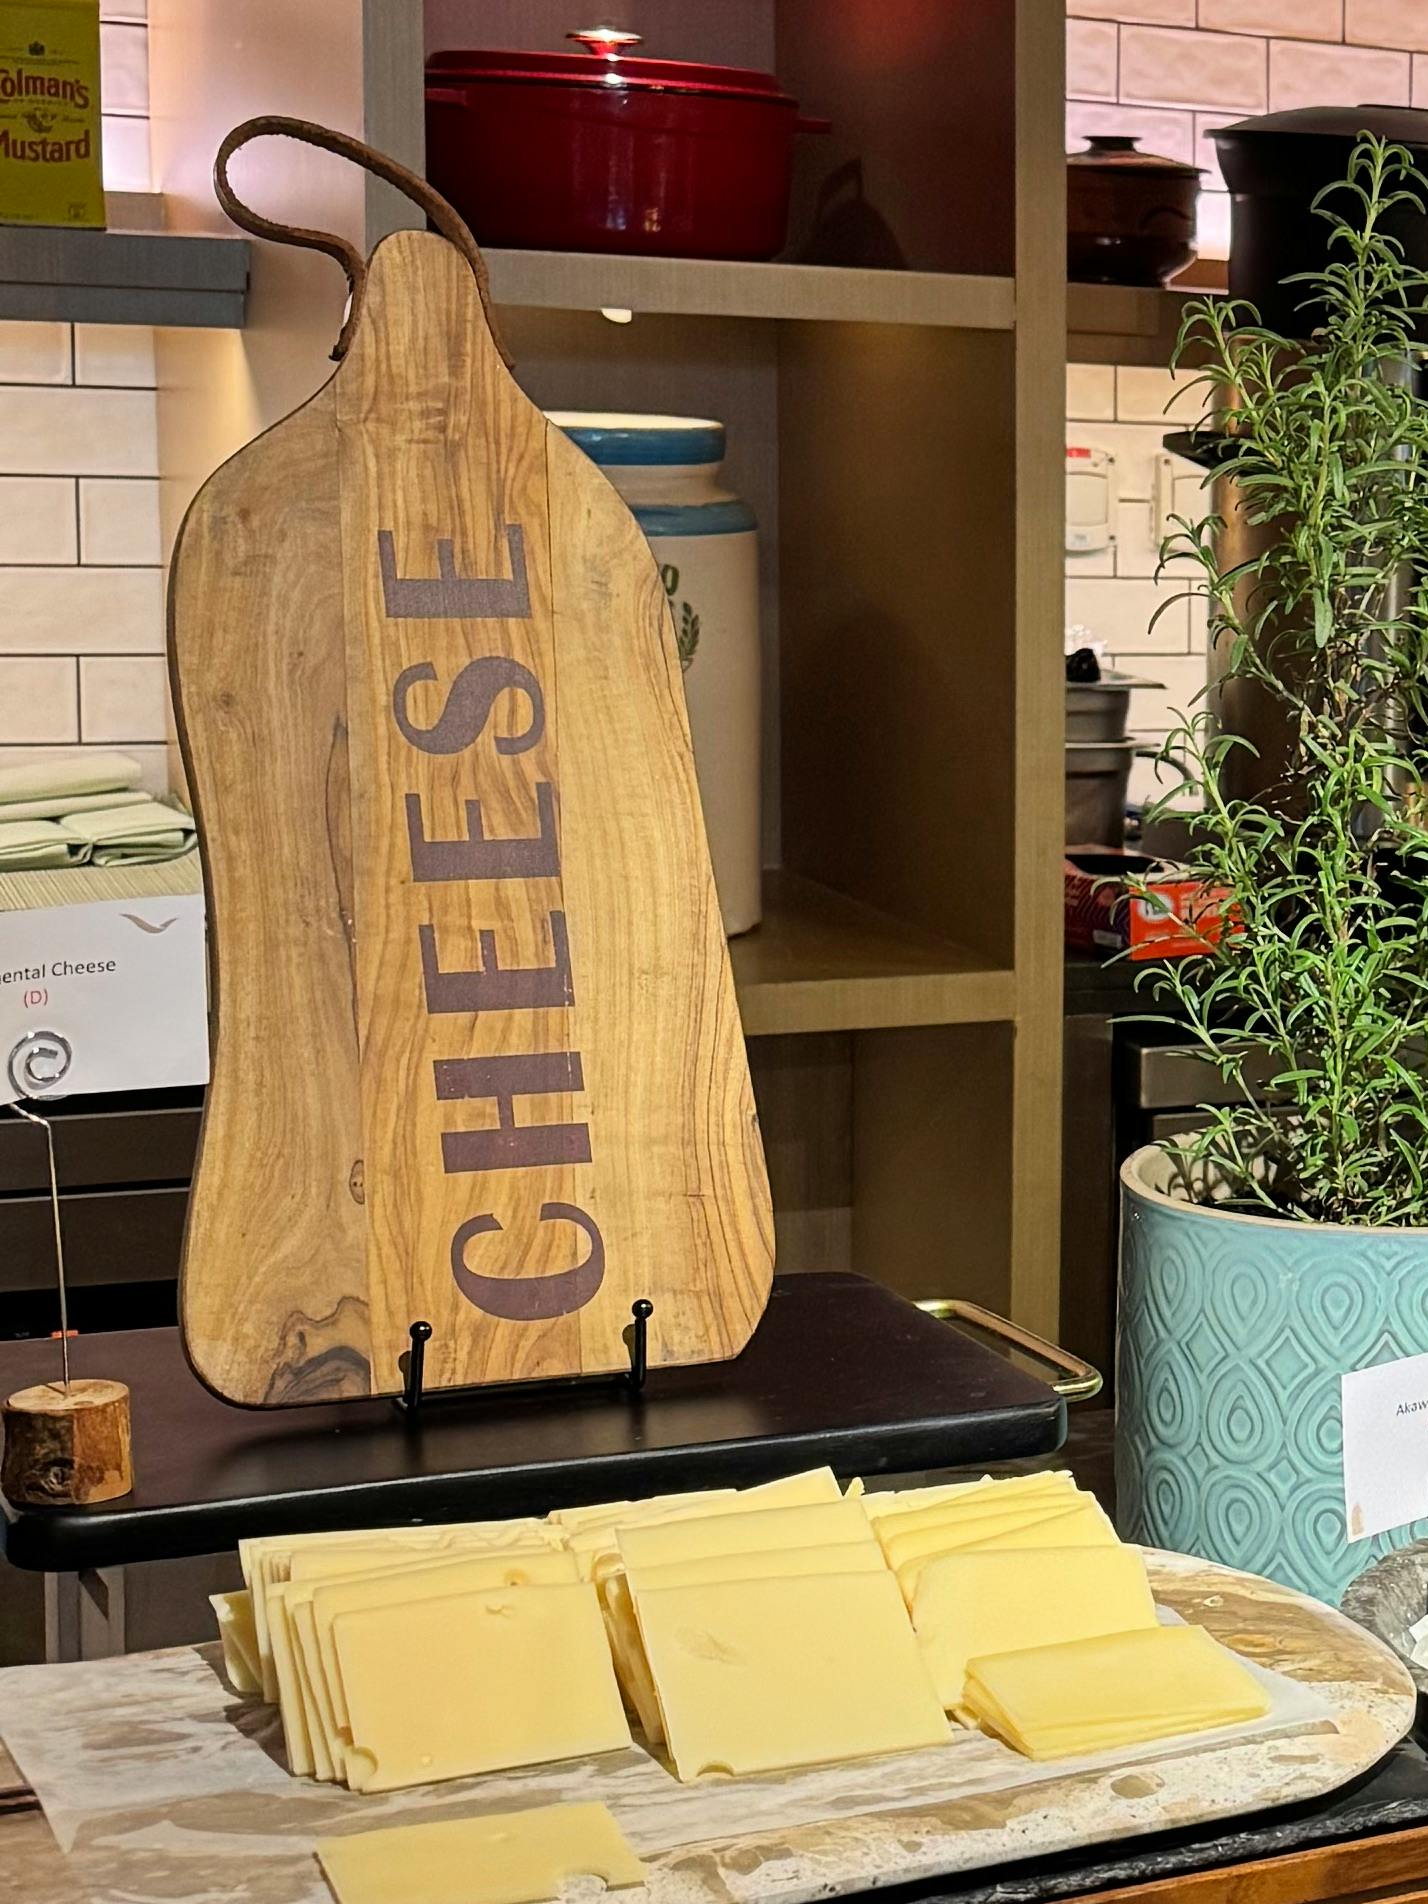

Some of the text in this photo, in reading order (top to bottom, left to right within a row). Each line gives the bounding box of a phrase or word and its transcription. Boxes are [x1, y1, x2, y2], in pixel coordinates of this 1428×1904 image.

[376, 522, 605, 1322] CHEESE
[0, 959, 117, 984] ental Cheese
[23, 988, 49, 1009] (D)
